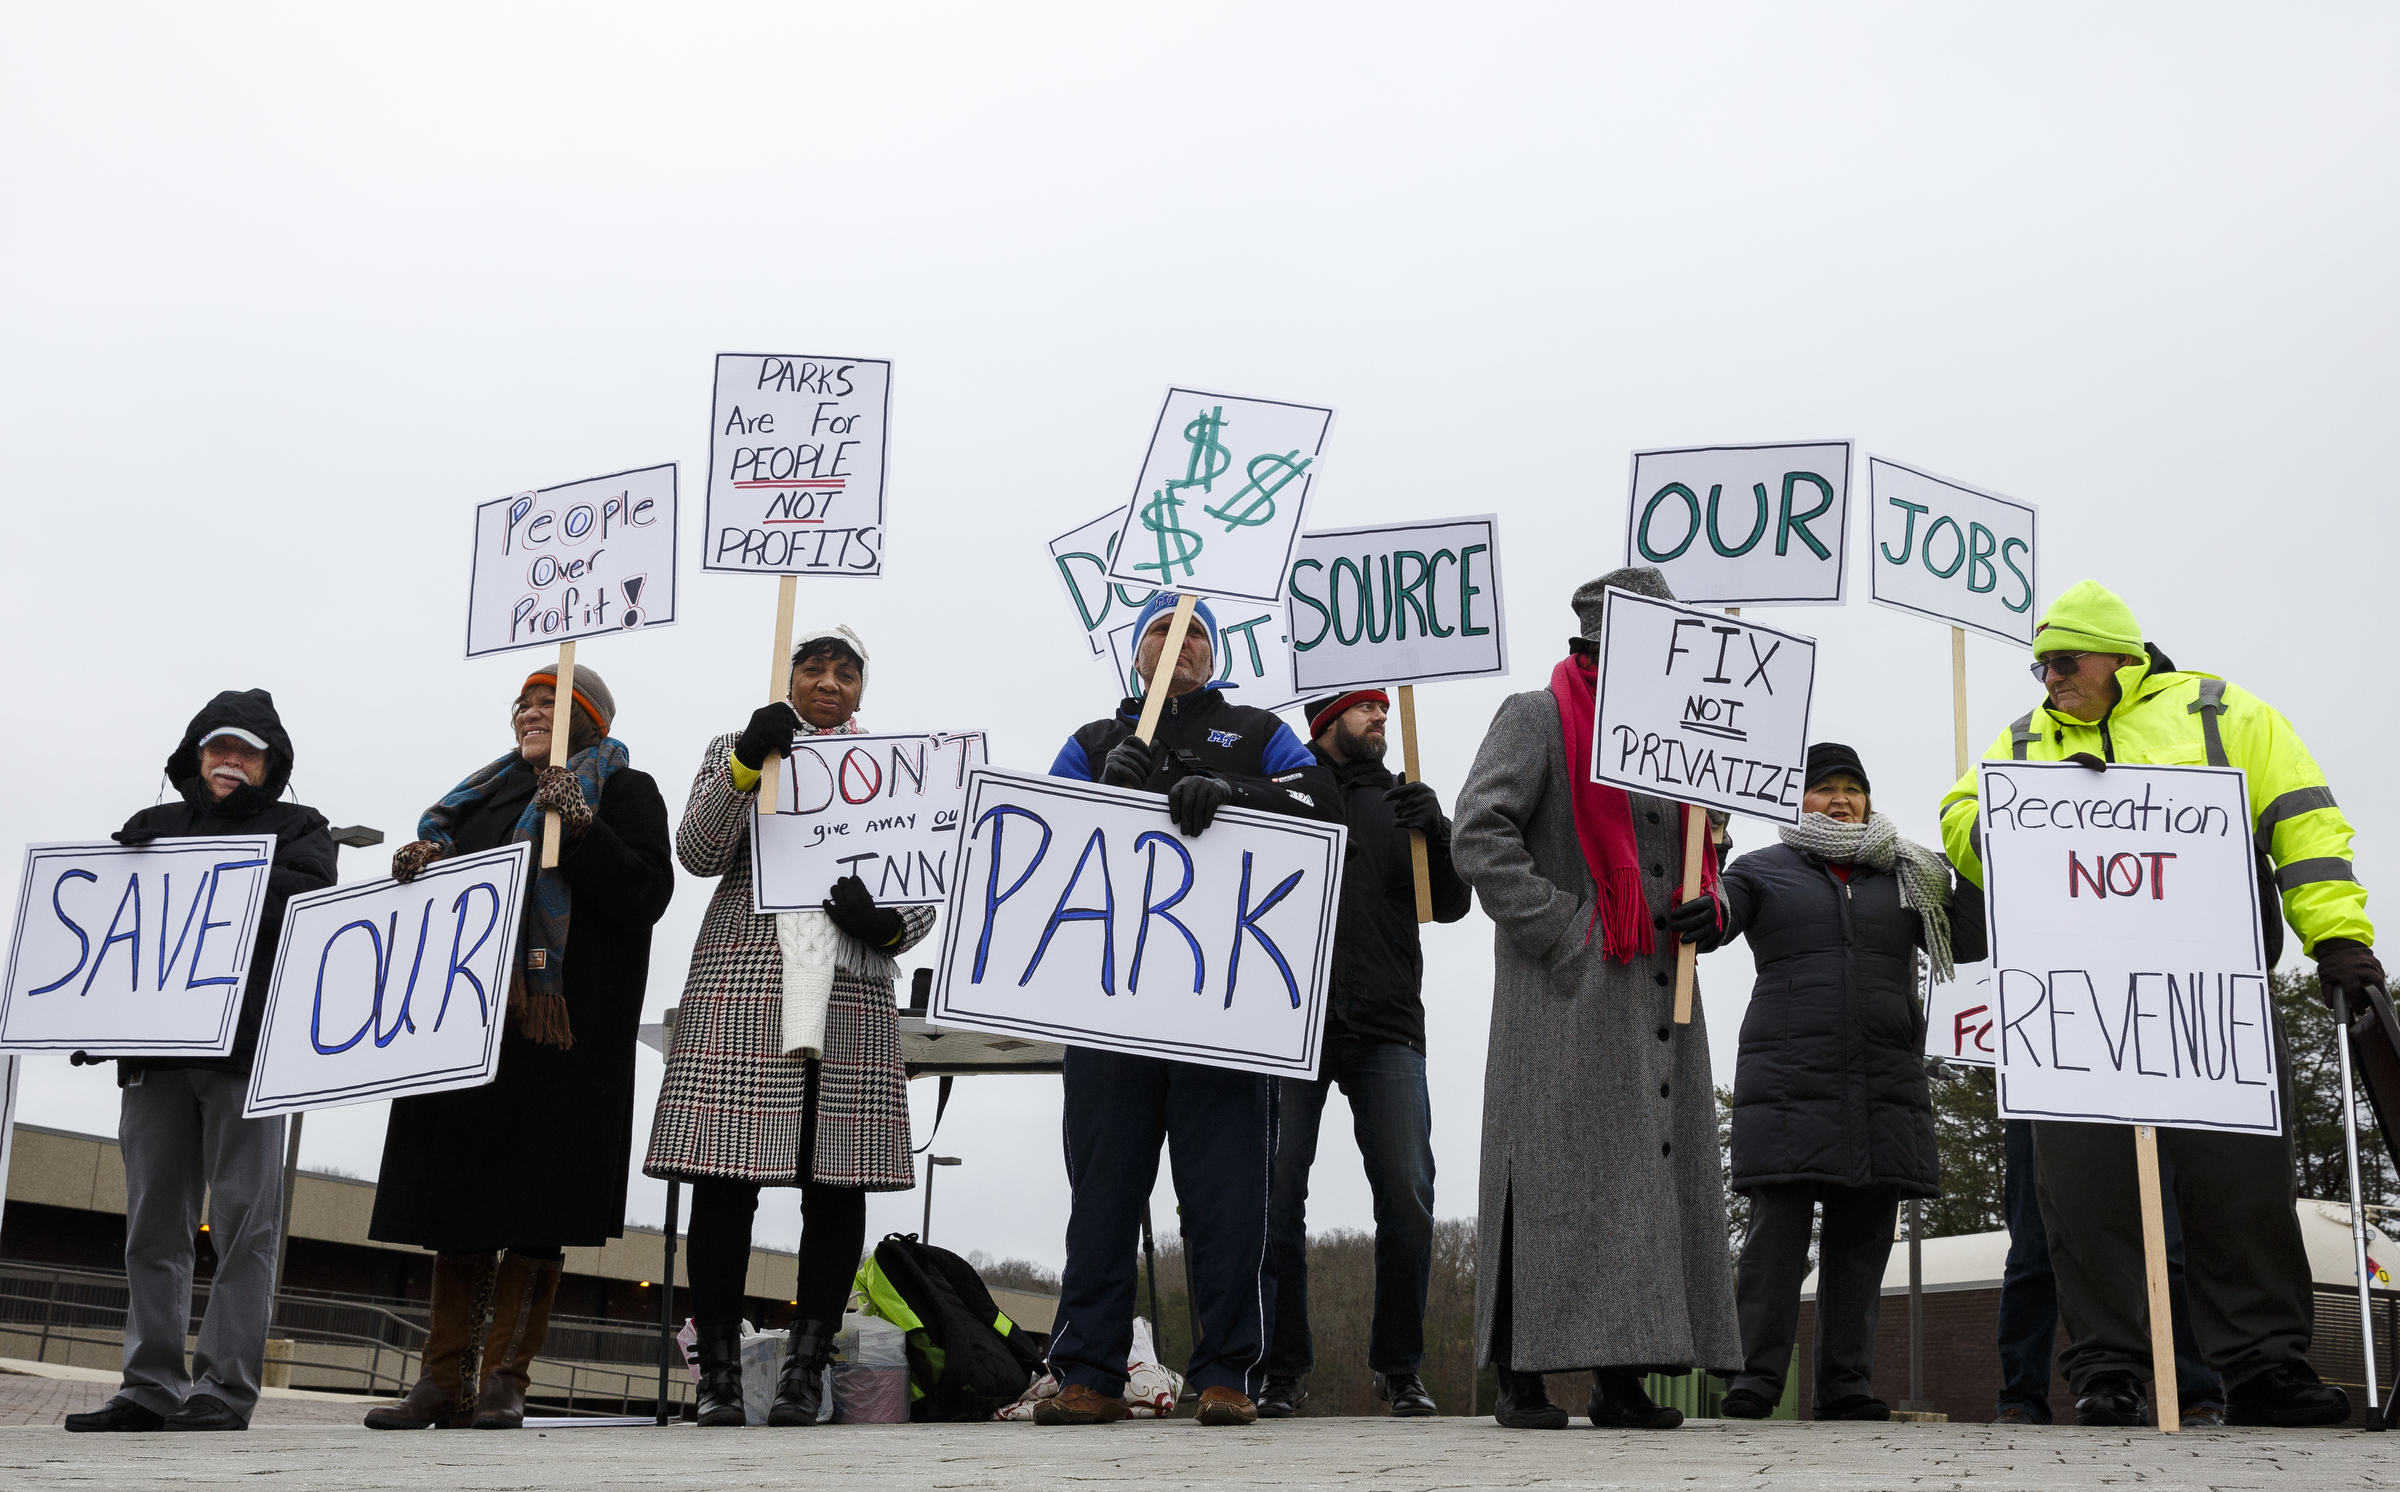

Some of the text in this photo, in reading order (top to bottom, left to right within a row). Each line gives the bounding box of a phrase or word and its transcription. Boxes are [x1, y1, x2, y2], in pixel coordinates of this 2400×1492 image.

[757, 358, 855, 396] PARKS
[725, 402, 862, 436] Are For
[731, 441, 861, 481] PEOPLE
[502, 490, 657, 557] People
[764, 491, 843, 519] NOT
[1637, 471, 1834, 563] OUR
[526, 549, 605, 590] Over
[717, 526, 878, 569] PROFITS
[1880, 497, 2032, 614] JOBS
[1289, 544, 1489, 651] SOURCE
[1665, 618, 1781, 695] FIX
[1683, 695, 1744, 728] NOT
[777, 732, 981, 815] DON'T
[1612, 725, 1804, 808] PRIVATIZE
[803, 822, 850, 848] give
[865, 813, 916, 833] AWAY
[1984, 772, 2228, 837] Recreation
[970, 804, 1305, 1010] PARK
[2068, 849, 2177, 900] NOT
[28, 858, 268, 997] SAVE
[310, 882, 501, 1055] OUR
[1999, 968, 2268, 1086] REVENUE
